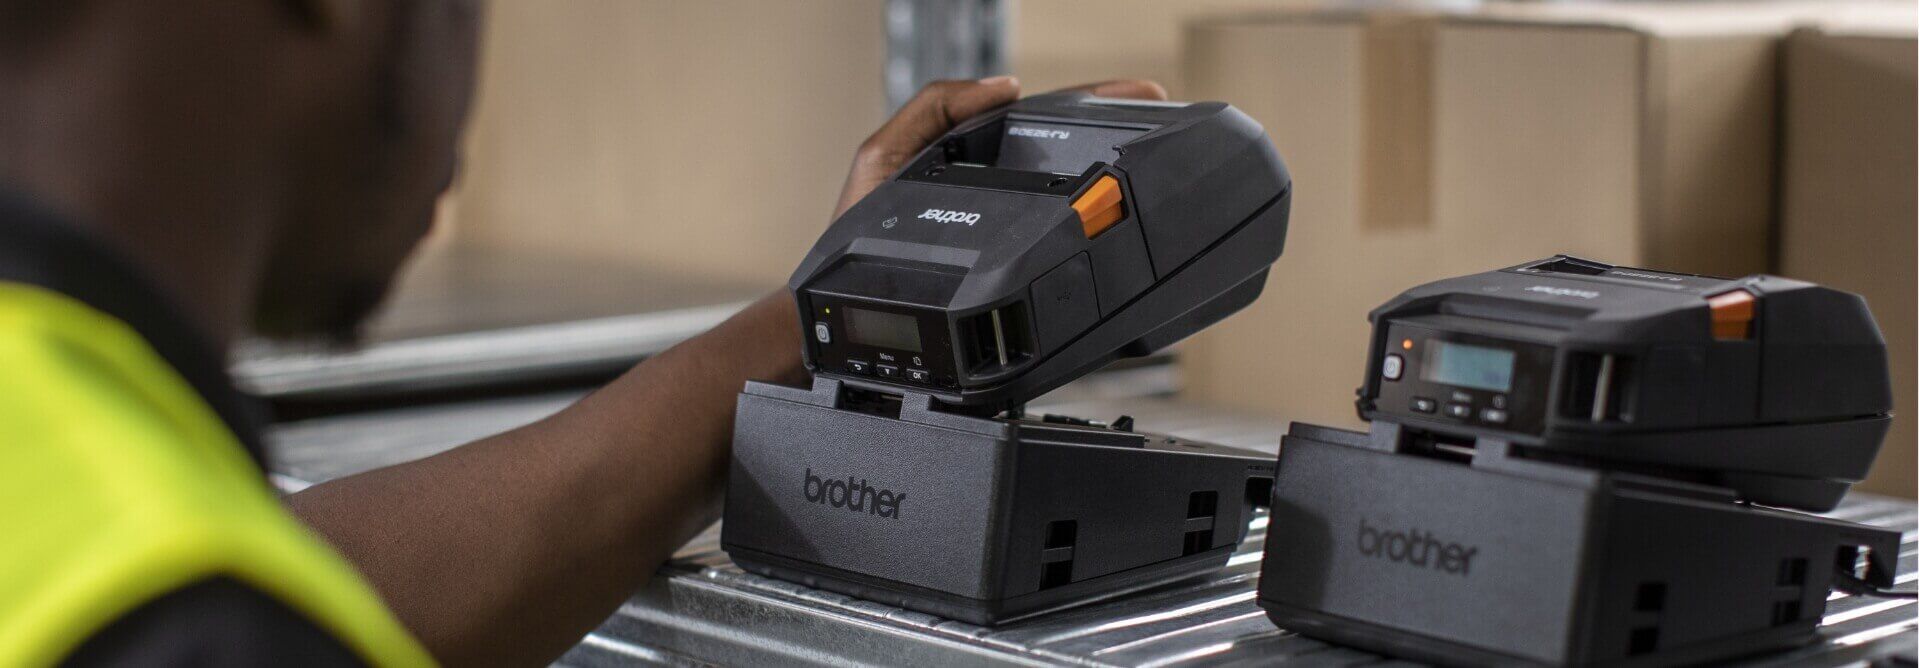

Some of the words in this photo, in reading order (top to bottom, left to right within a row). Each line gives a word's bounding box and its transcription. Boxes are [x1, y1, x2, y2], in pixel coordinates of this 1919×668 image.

[918, 208, 981, 226] brother
[879, 353, 895, 361] Menu
[913, 372, 922, 380] OK
[804, 467, 906, 520] brother
[1359, 518, 1478, 577] brother
